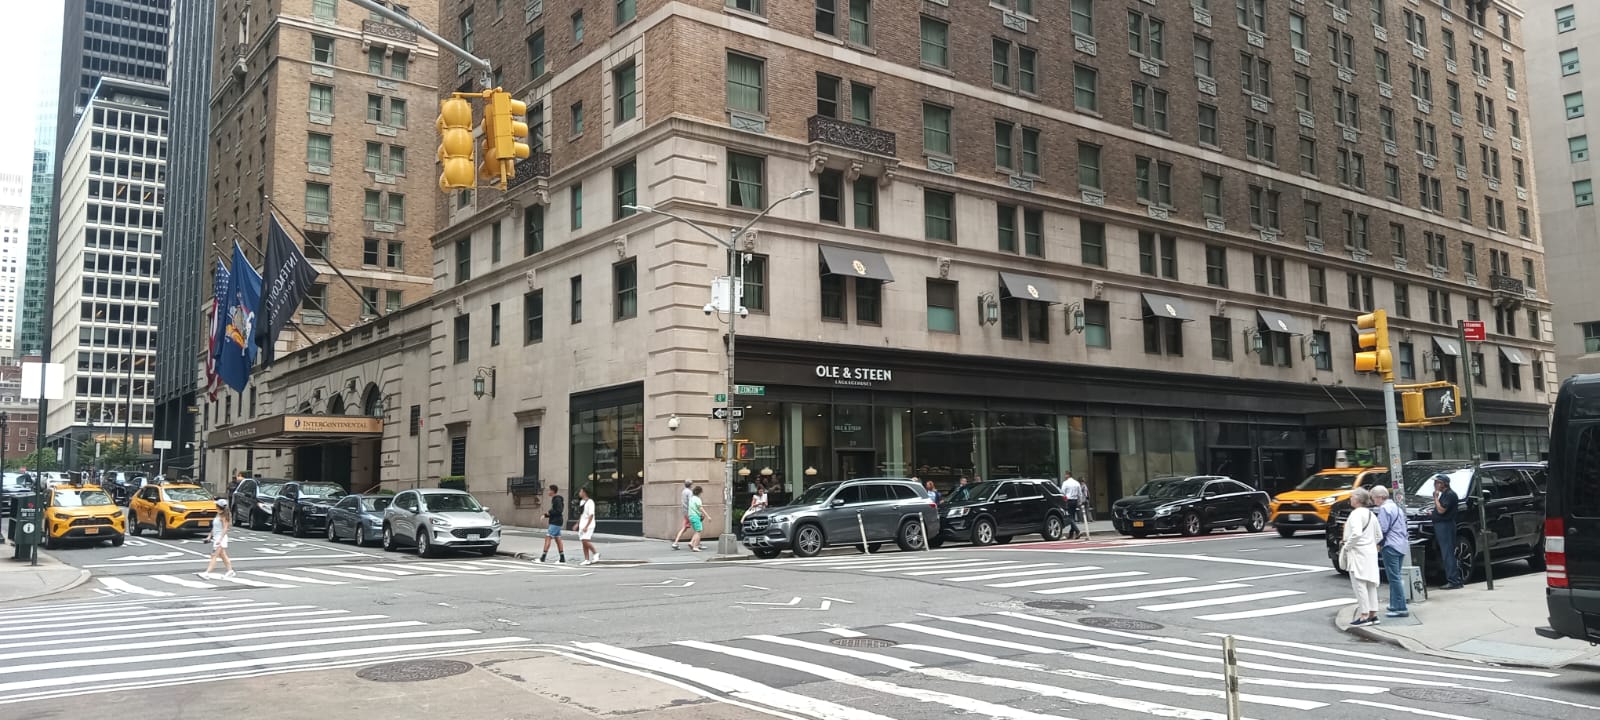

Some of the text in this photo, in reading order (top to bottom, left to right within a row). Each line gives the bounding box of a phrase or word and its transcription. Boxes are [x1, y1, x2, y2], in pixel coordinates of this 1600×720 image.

[815, 365, 892, 381] OLE & STEEN
